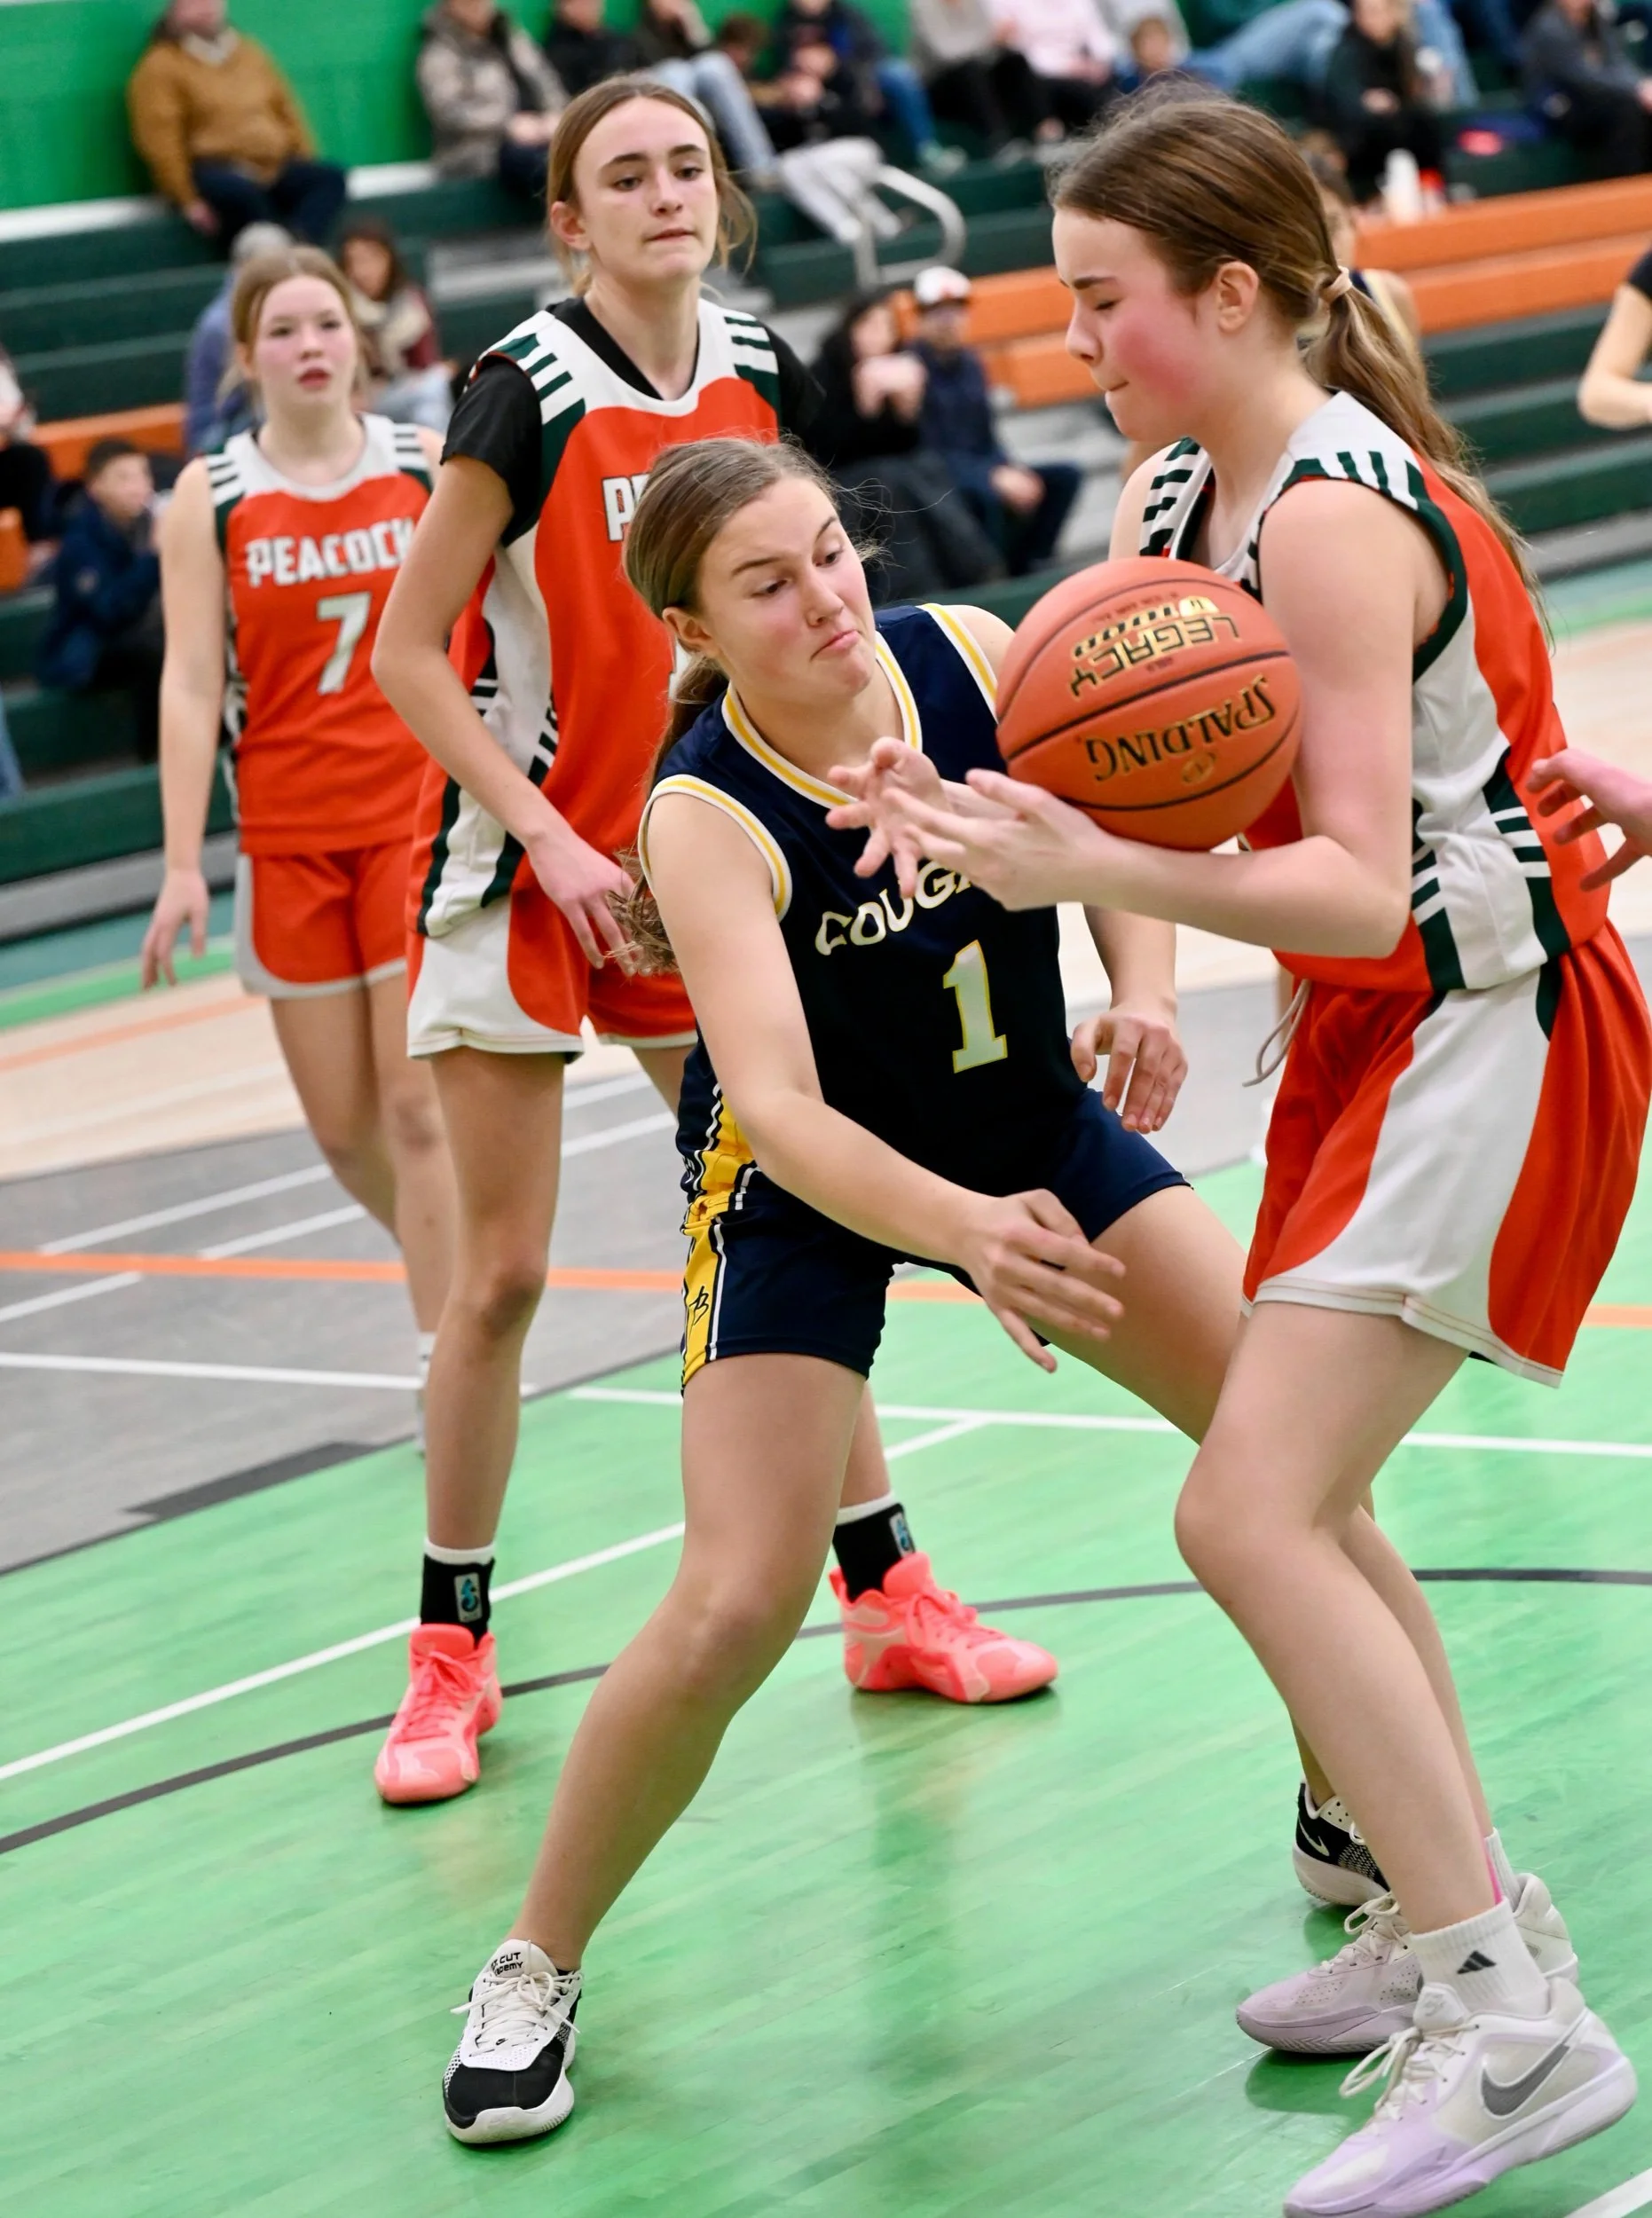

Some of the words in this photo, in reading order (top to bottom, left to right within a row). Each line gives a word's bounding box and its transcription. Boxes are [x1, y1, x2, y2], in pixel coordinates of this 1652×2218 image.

[316, 590, 371, 695] 7
[1068, 614, 1240, 700] LEGACY
[1085, 674, 1276, 782] SPALDING
[942, 939, 1008, 1074] 1
[500, 1952, 522, 1964] CUT
